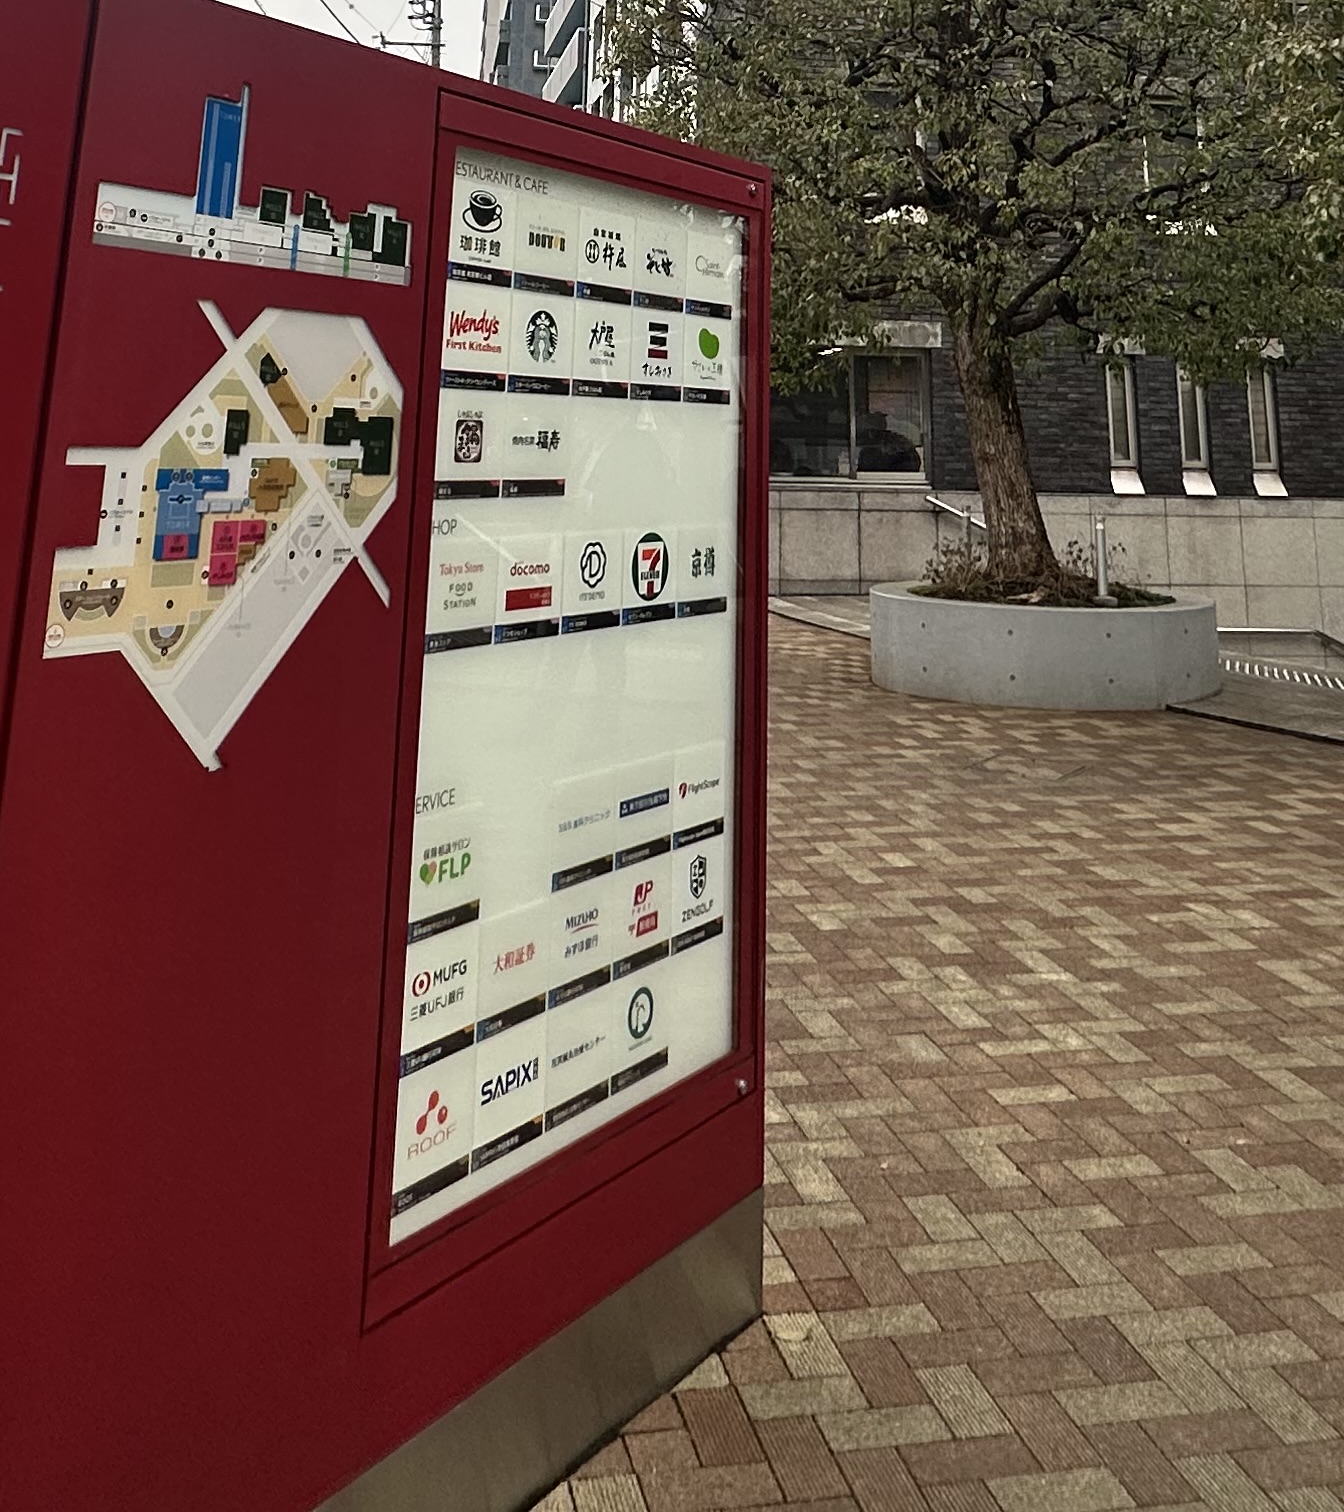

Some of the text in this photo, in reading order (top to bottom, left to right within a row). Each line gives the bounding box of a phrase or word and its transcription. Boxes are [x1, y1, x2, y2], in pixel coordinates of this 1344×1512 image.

[523, 176, 549, 195] CAFE
[528, 231, 566, 252] DOUTOR
[449, 309, 500, 341] Wendy's
[446, 339, 502, 353] First Kitchen
[439, 560, 484, 577] Tokyu Store
[509, 561, 551, 577] docomo
[448, 581, 474, 594] FOOD
[443, 596, 477, 611] STATION
[415, 787, 456, 815] ERVICE
[437, 851, 472, 884] FLP
[565, 907, 600, 931] MIZUHO
[432, 959, 468, 987] MUFG
[409, 986, 465, 1022] 三菱UFJ銀行
[480, 1059, 533, 1106] SAPIX
[407, 1123, 457, 1161] ROOF
